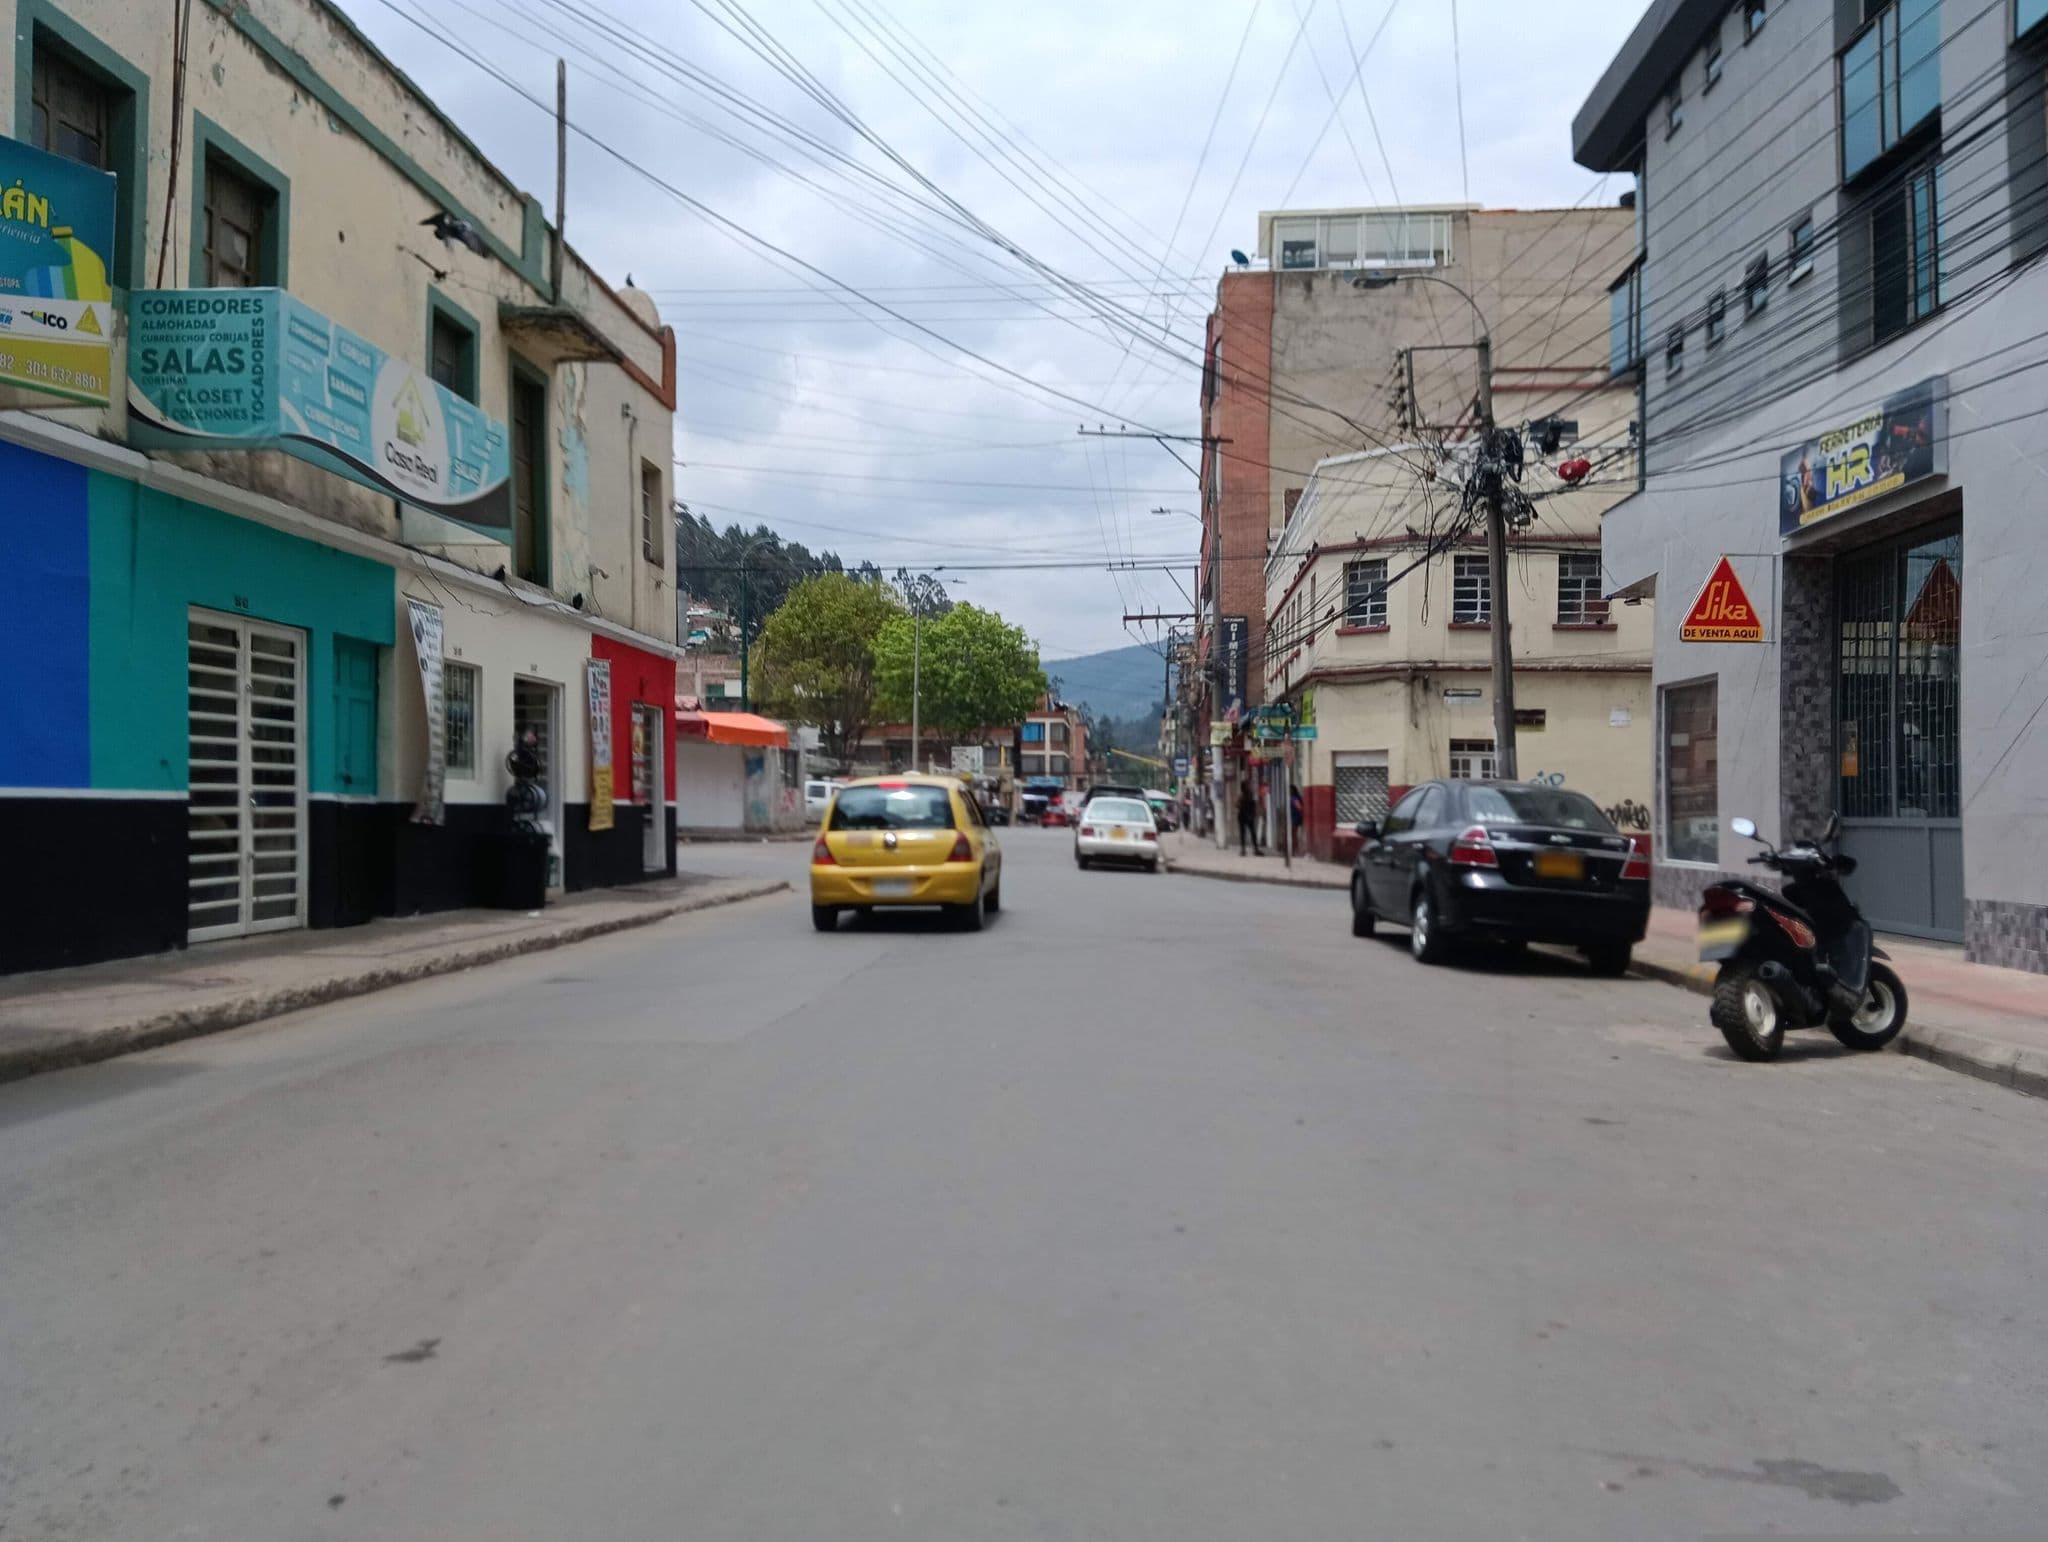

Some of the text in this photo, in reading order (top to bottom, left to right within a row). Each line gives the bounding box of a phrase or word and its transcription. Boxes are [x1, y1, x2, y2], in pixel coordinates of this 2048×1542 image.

[0, 179, 48, 228] ÁN
[141, 299, 264, 315] COMEDORES
[142, 319, 216, 330] ALMOHADAS
[209, 332, 249, 344] COBIJAS
[141, 347, 245, 375] SALAS
[251, 317, 265, 423] TOCADORES
[175, 388, 244, 404] CLOSET
[171, 407, 248, 420] COLCHONES
[1826, 444, 1874, 500] HR
[1695, 580, 1748, 620] Sika
[1683, 628, 1697, 638] DE
[1699, 628, 1731, 639] VENTA
